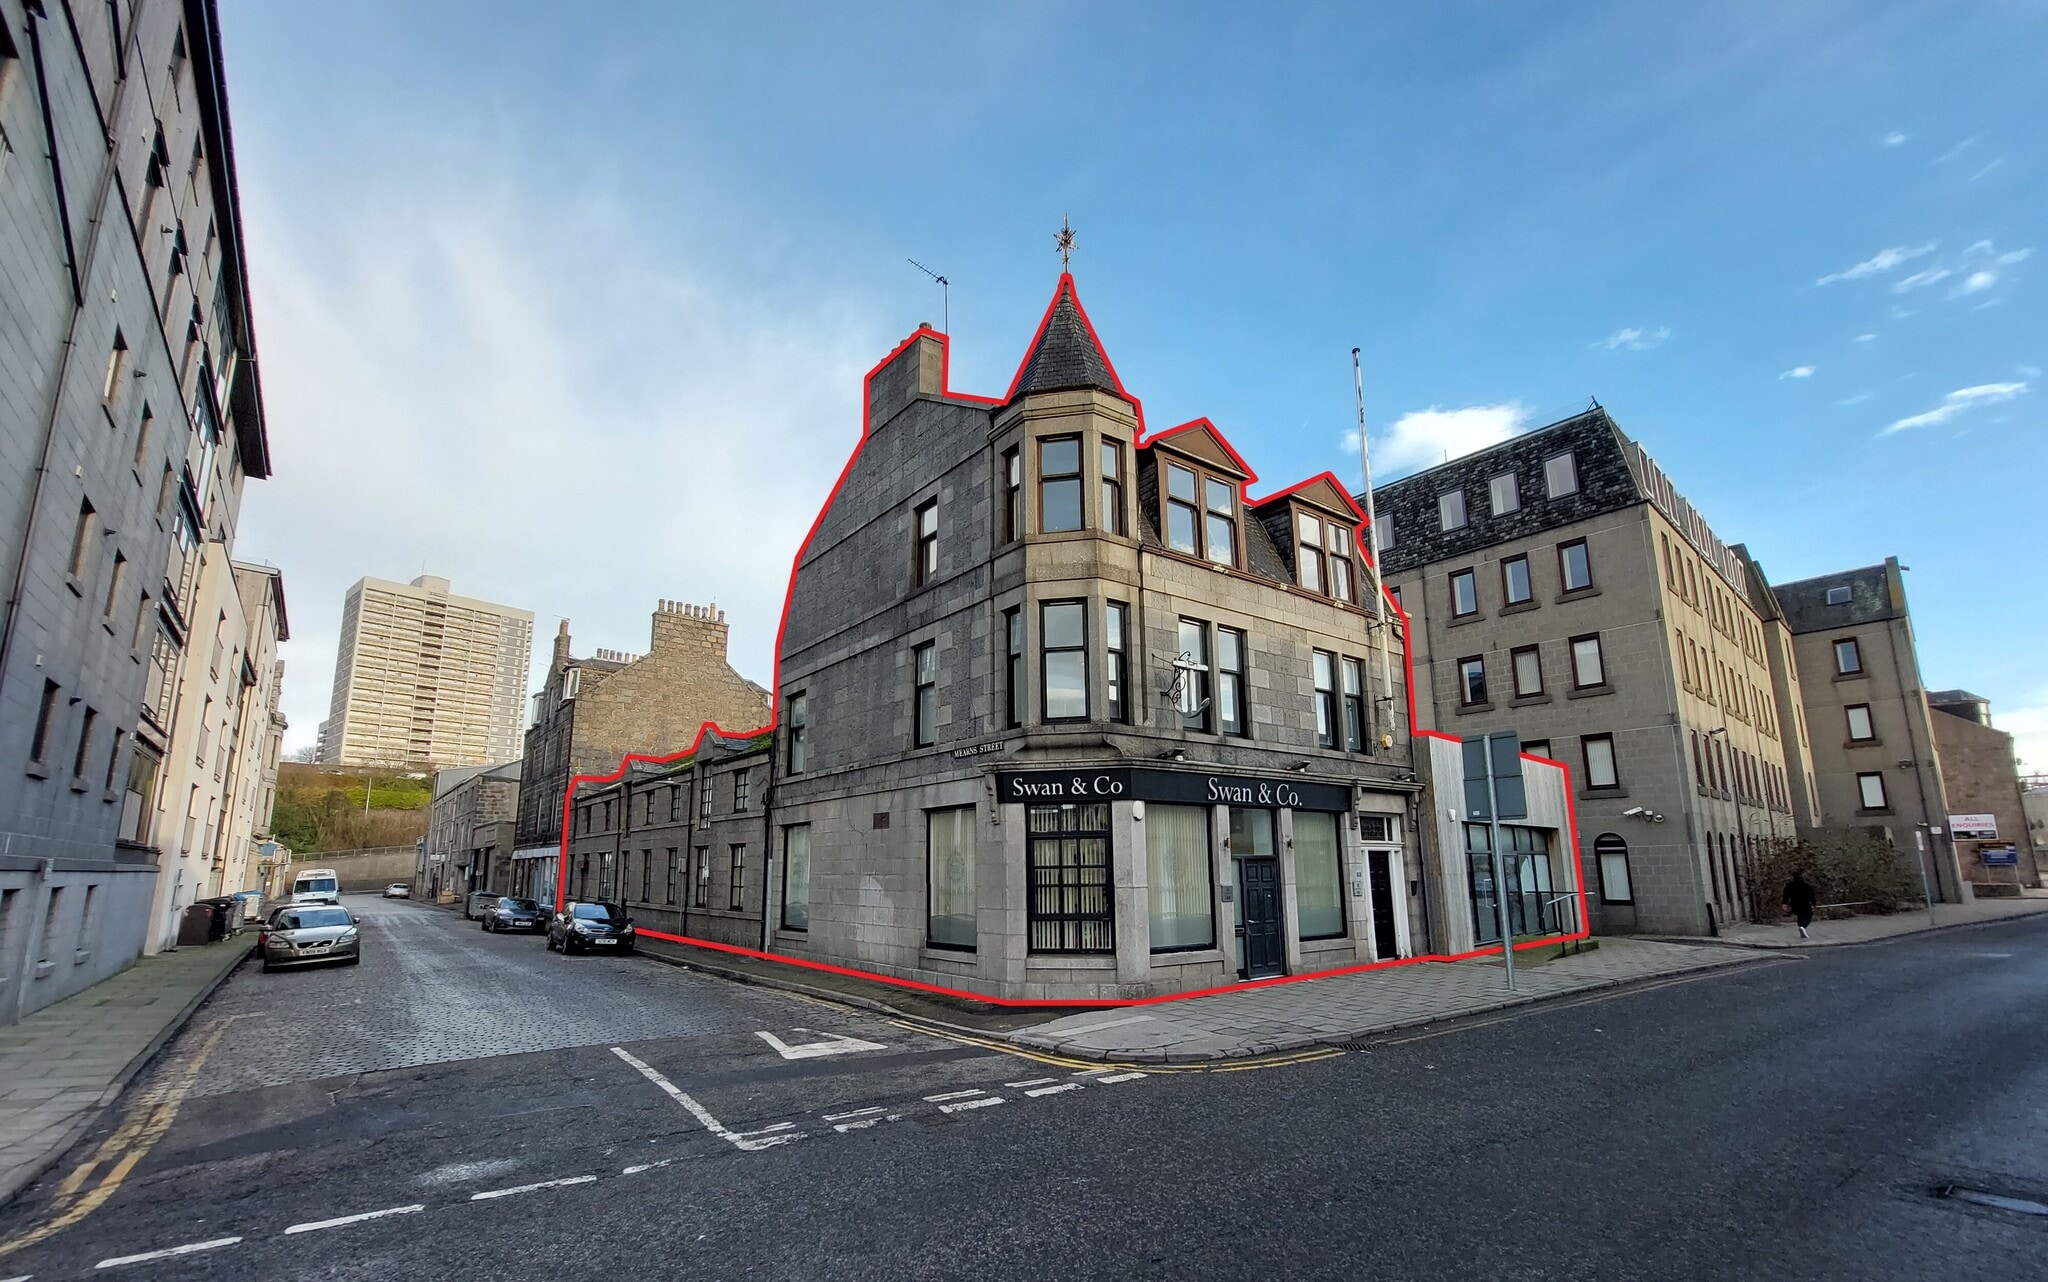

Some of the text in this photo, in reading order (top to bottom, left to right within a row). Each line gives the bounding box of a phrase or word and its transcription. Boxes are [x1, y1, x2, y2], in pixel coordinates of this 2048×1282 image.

[954, 741, 1004, 758] MEARNS STREET
[1012, 775, 1123, 797] Swan & Co
[1207, 777, 1303, 807] Swan & Co.
